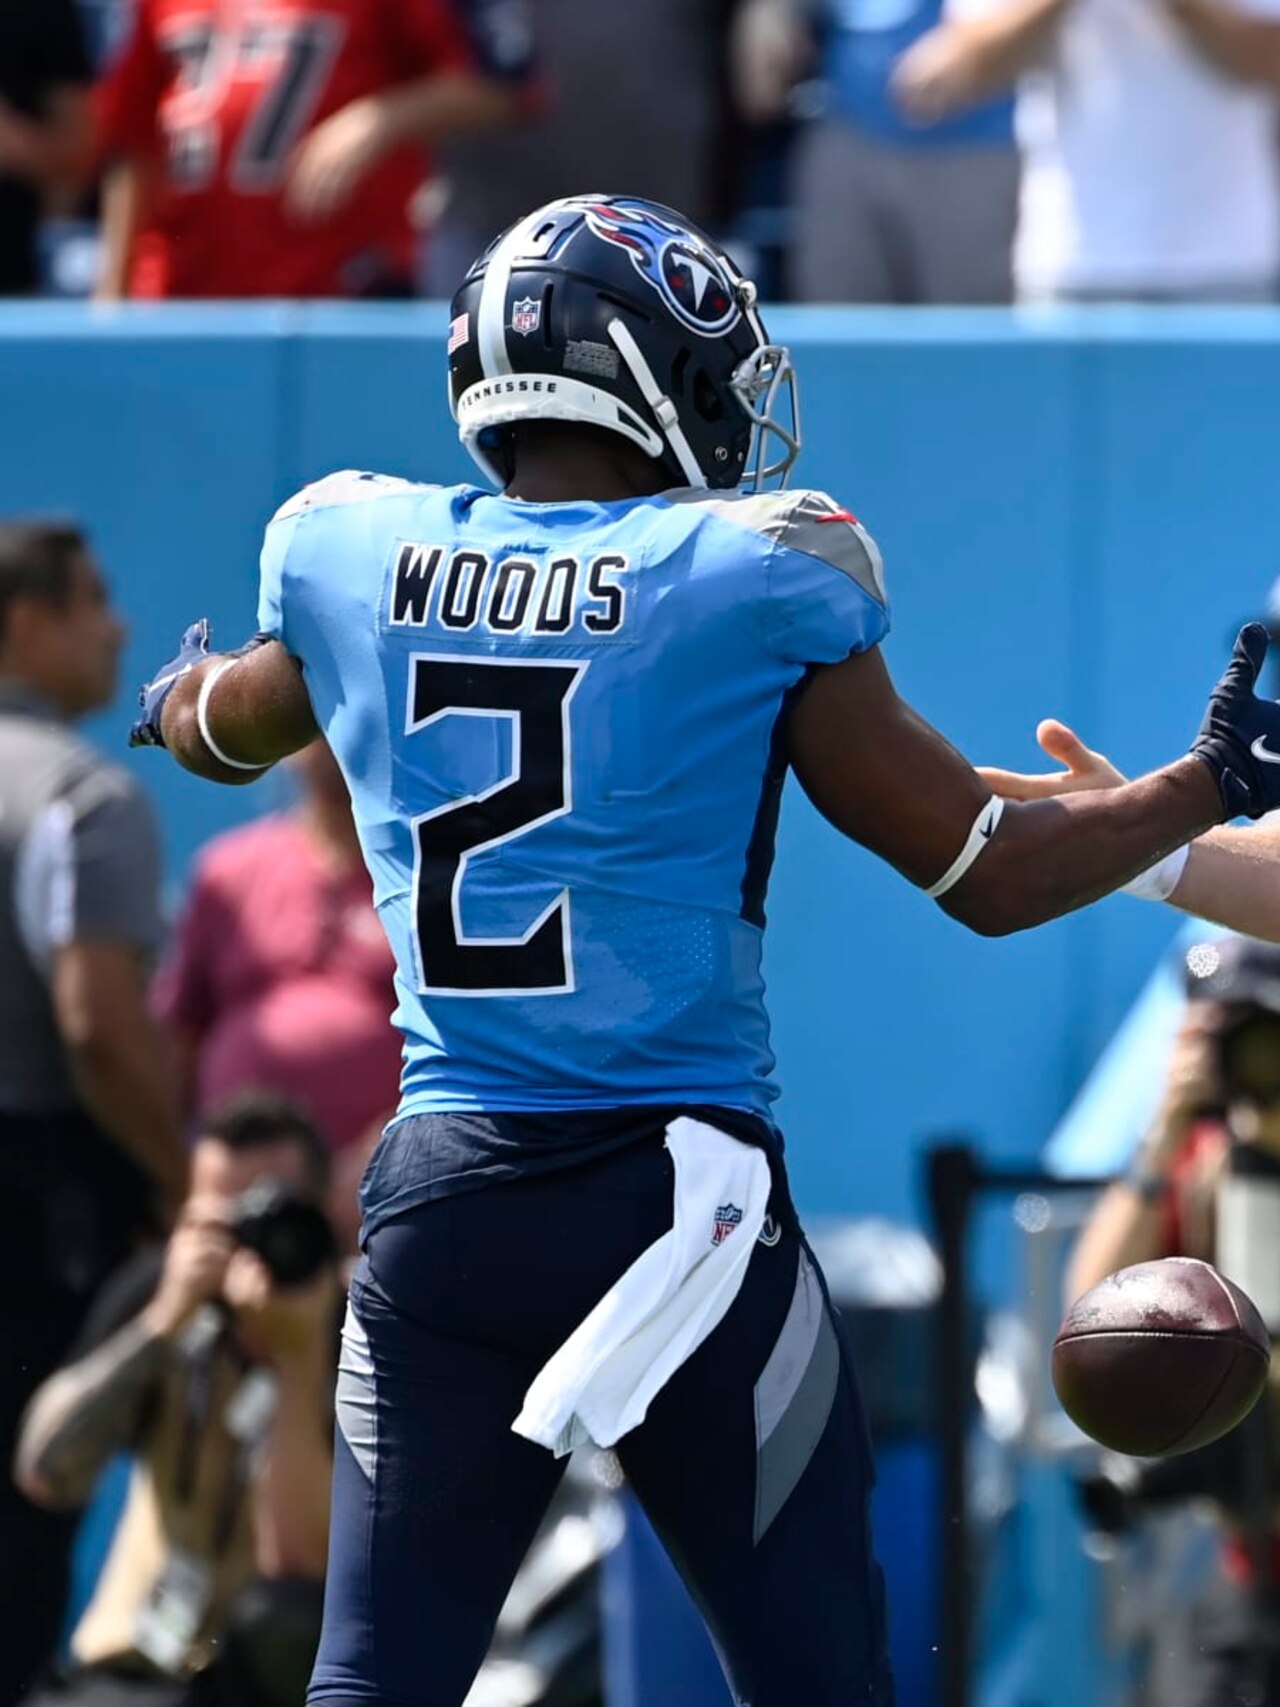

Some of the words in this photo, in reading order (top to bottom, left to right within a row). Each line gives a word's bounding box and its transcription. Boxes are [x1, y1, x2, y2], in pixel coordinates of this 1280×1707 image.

[389, 541, 631, 636] WOODS
[405, 652, 591, 996] 2
[713, 1222, 738, 1243] NF
